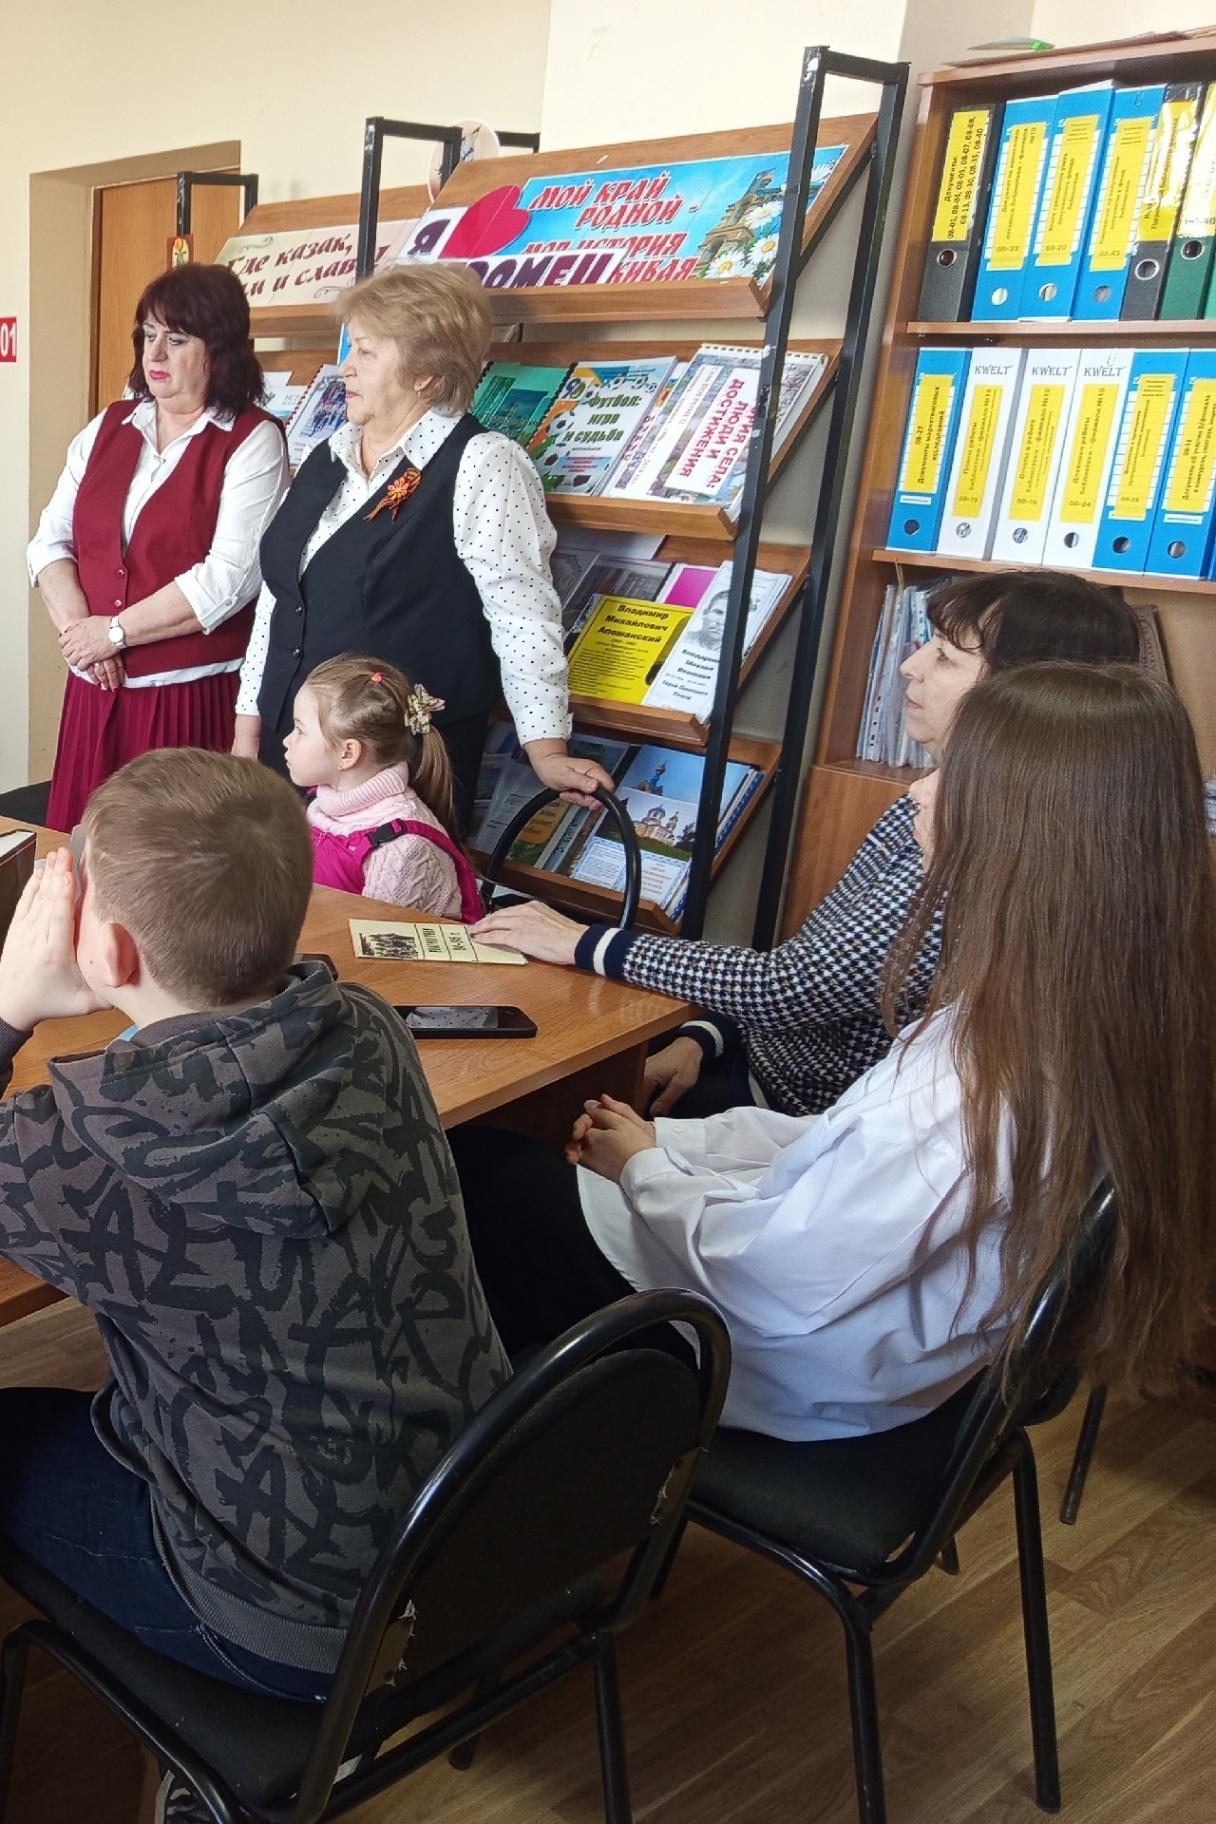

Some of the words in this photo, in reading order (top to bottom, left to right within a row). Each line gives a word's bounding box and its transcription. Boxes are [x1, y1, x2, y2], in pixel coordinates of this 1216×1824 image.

[529, 179, 594, 210] МОЙ
[593, 170, 671, 202] КРАЙ
[575, 195, 683, 231] РОДНОЙ
[408, 218, 451, 256] Я
[226, 255, 270, 277] Где
[274, 234, 353, 267] казак,
[0, 322, 16, 358] 01
[973, 364, 1014, 376] KWELT
[1031, 365, 1073, 377] KWELT
[1083, 366, 1127, 378] KWELT
[588, 394, 643, 409] Футбол:
[587, 413, 621, 426] игра
[679, 378, 745, 478] ДОСТИЖЕНИЯ
[715, 400, 749, 445] ЛЮДИ
[574, 429, 625, 444] судьба
[707, 447, 738, 489] СЕЛА:
[604, 614, 668, 631] Михайлович
[617, 604, 669, 620] Владимир
